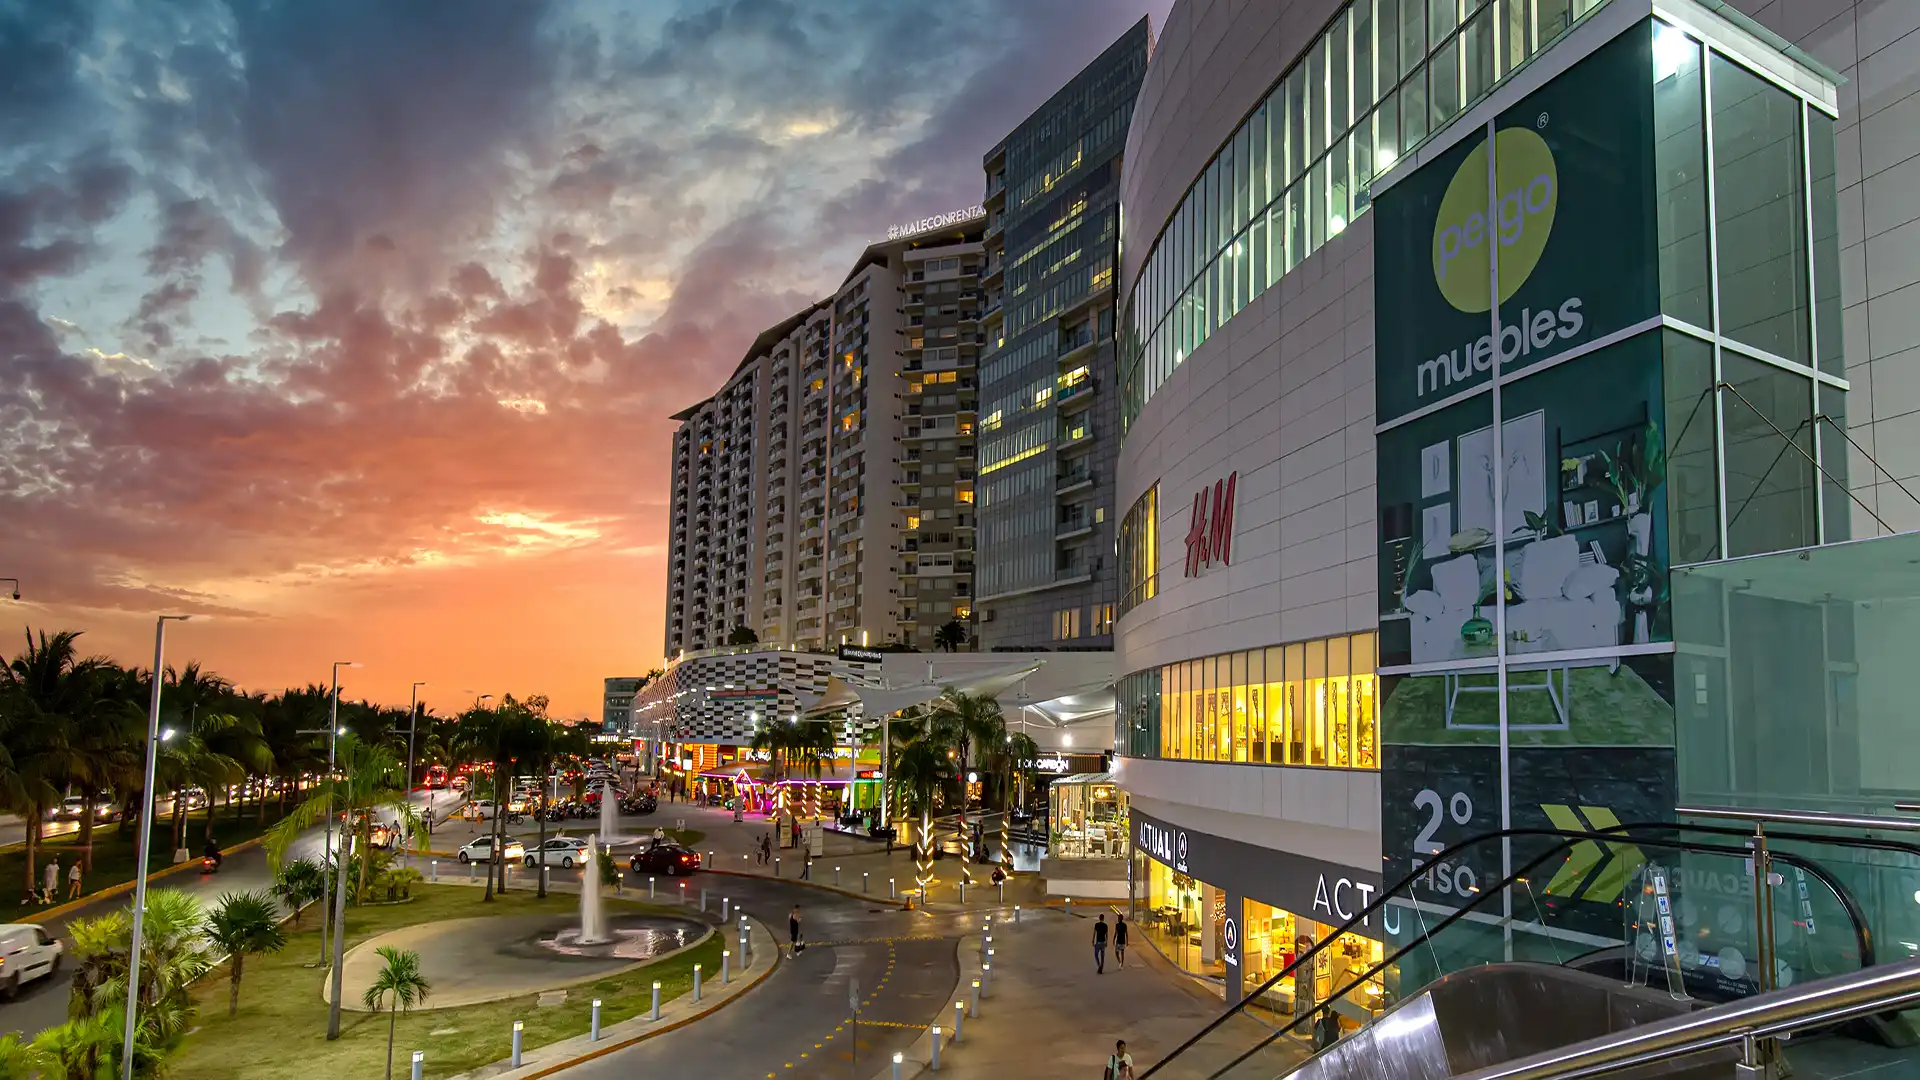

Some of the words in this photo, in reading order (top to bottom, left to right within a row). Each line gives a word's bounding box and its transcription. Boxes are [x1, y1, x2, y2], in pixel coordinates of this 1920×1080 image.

[887, 203, 987, 240] #MALECONRENTA
[1439, 173, 1554, 281] pego
[1417, 296, 1584, 397] muebles
[1184, 470, 1237, 578] H&M
[1139, 821, 1171, 861] ACTUAL
[1411, 858, 1476, 898] PISO
